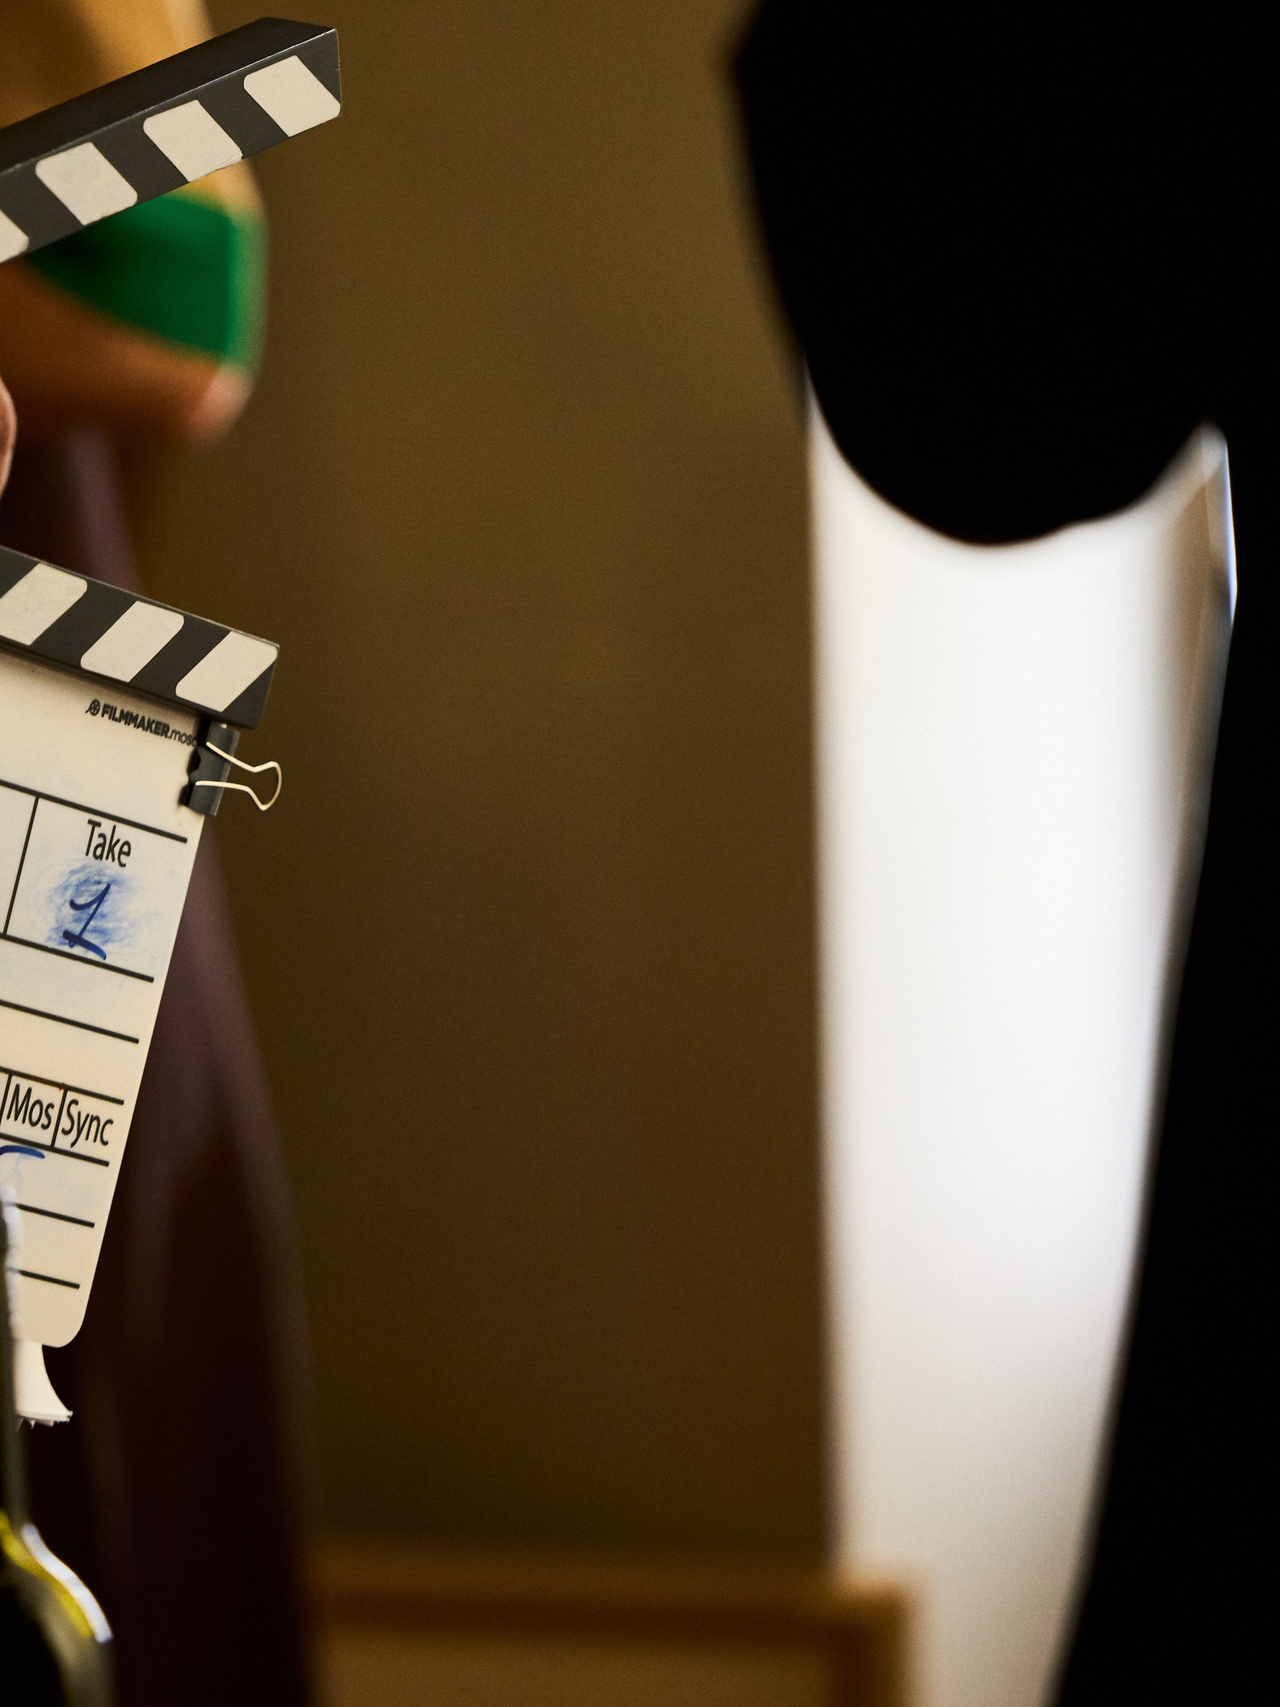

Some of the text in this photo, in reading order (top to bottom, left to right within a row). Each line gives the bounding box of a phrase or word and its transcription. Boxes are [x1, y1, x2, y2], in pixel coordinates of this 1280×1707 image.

[85, 819, 132, 868] Take
[7, 1083, 55, 1130] Mos
[61, 1098, 114, 1148] Sync
